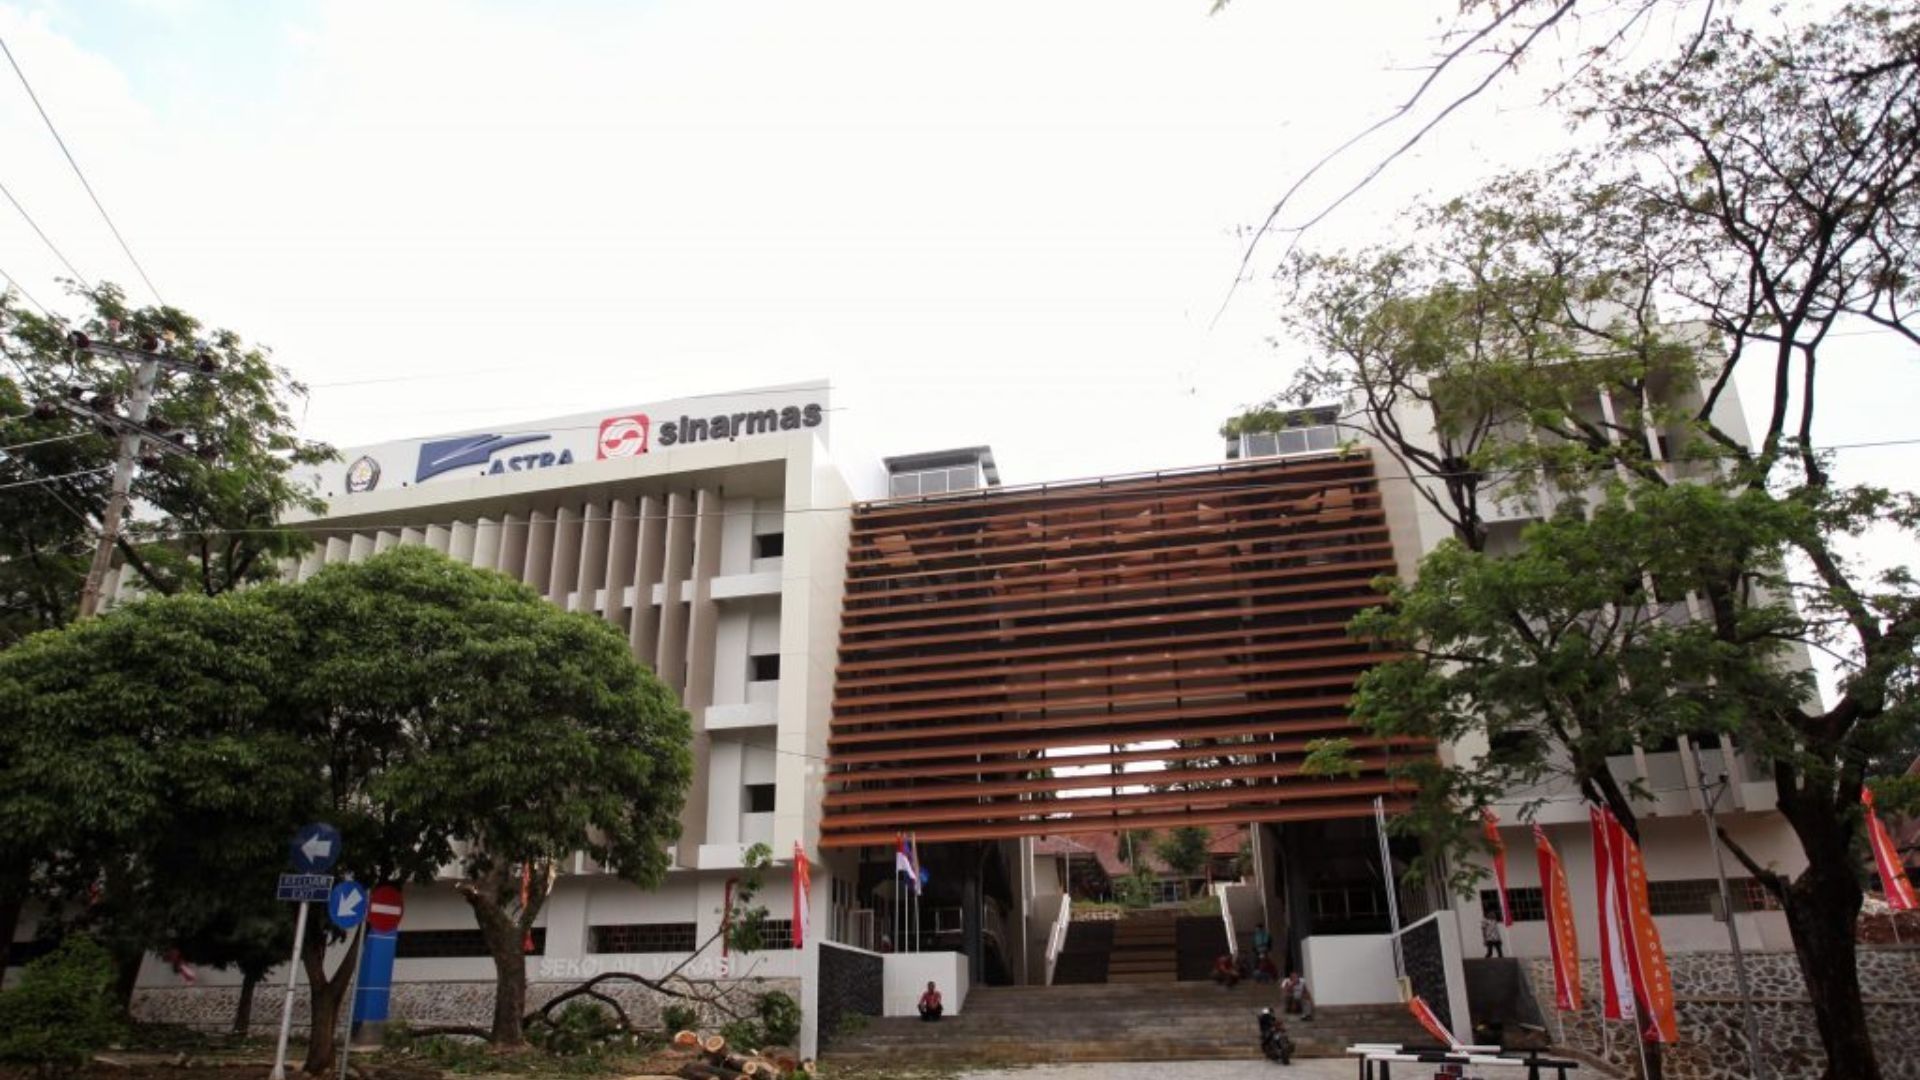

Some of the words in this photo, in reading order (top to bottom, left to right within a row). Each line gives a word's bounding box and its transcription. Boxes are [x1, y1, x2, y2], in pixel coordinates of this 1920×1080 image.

[658, 403, 822, 446] sinarmas
[489, 448, 574, 474] ASTRA
[540, 957, 639, 978] SEKOAH
